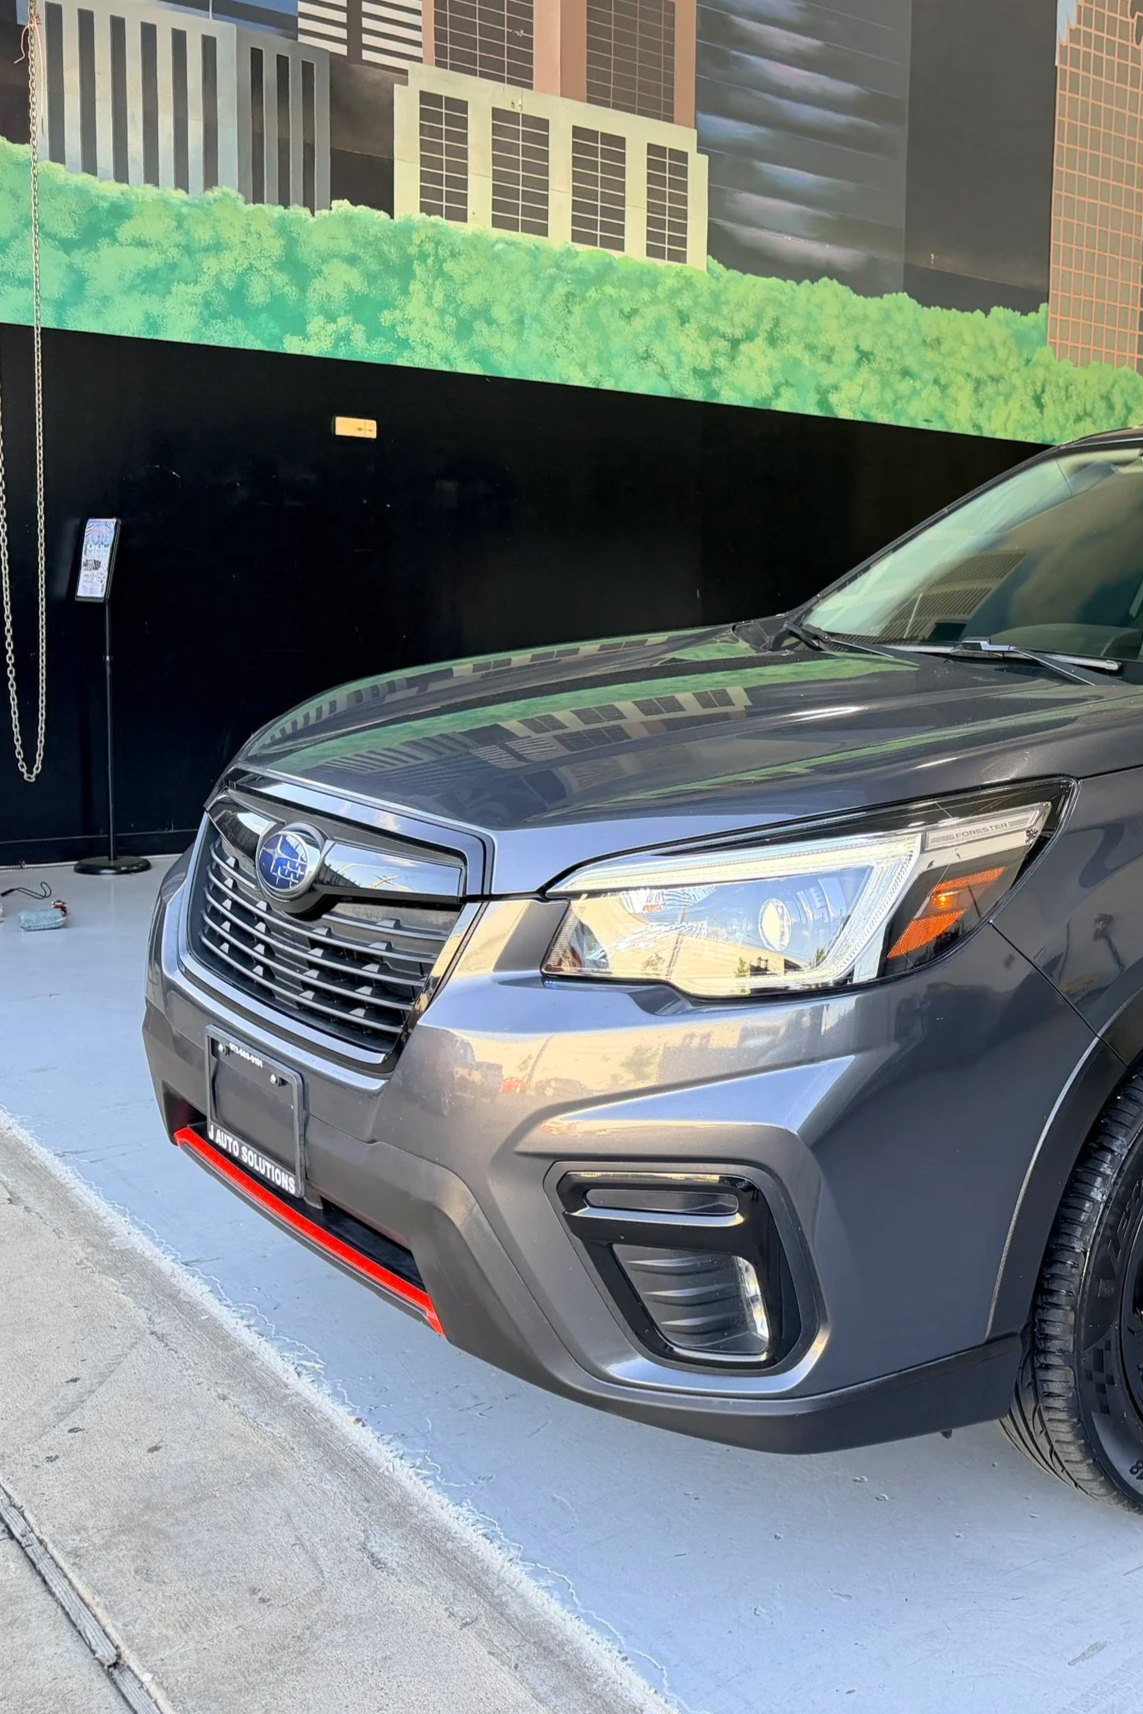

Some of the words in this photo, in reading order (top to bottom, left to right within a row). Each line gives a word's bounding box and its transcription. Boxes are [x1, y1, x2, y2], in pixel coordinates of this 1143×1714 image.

[955, 822, 1009, 839] FORESTER
[208, 1124, 214, 1140] J
[215, 1128, 240, 1157] AUTO
[241, 1145, 296, 1195] SOLUTIONS
